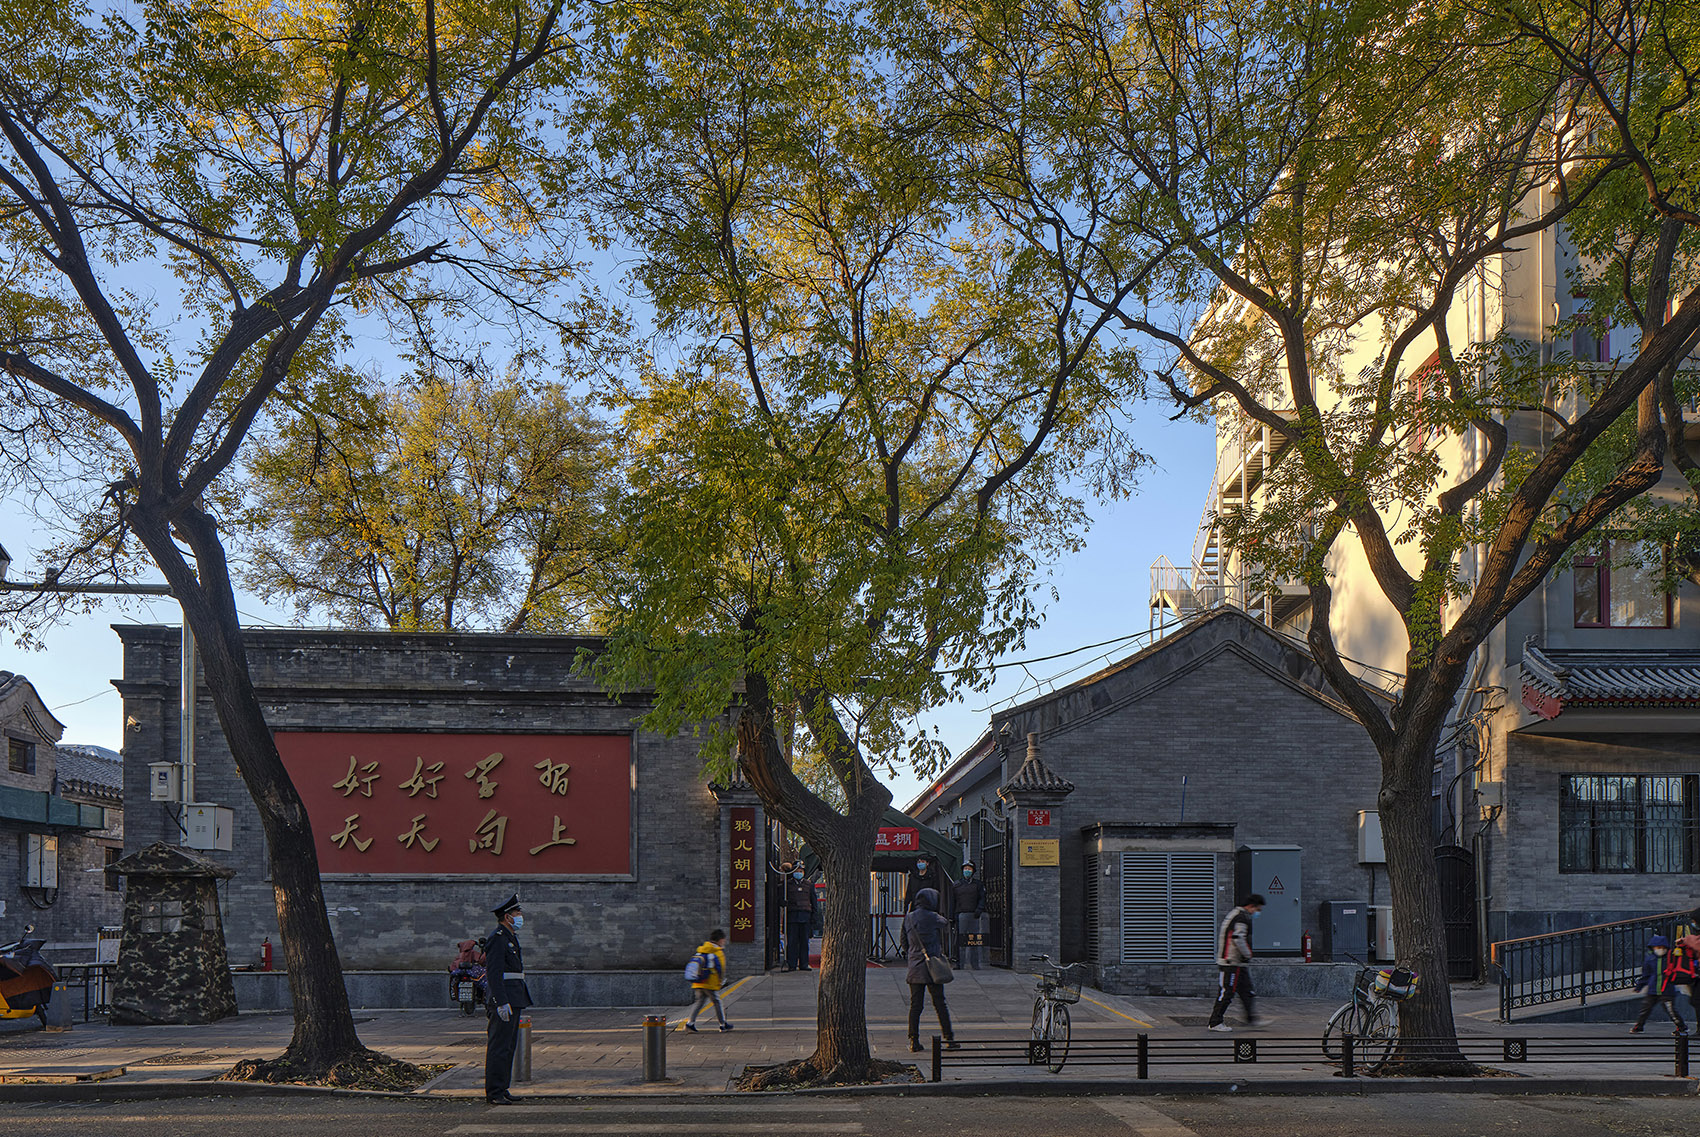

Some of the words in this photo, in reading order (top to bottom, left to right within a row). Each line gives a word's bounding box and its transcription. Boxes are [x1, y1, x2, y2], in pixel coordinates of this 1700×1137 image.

[330, 809, 577, 855] 天天向上
[1034, 816, 1043, 825] 25
[733, 819, 752, 931] 鸦儿胡同小学
